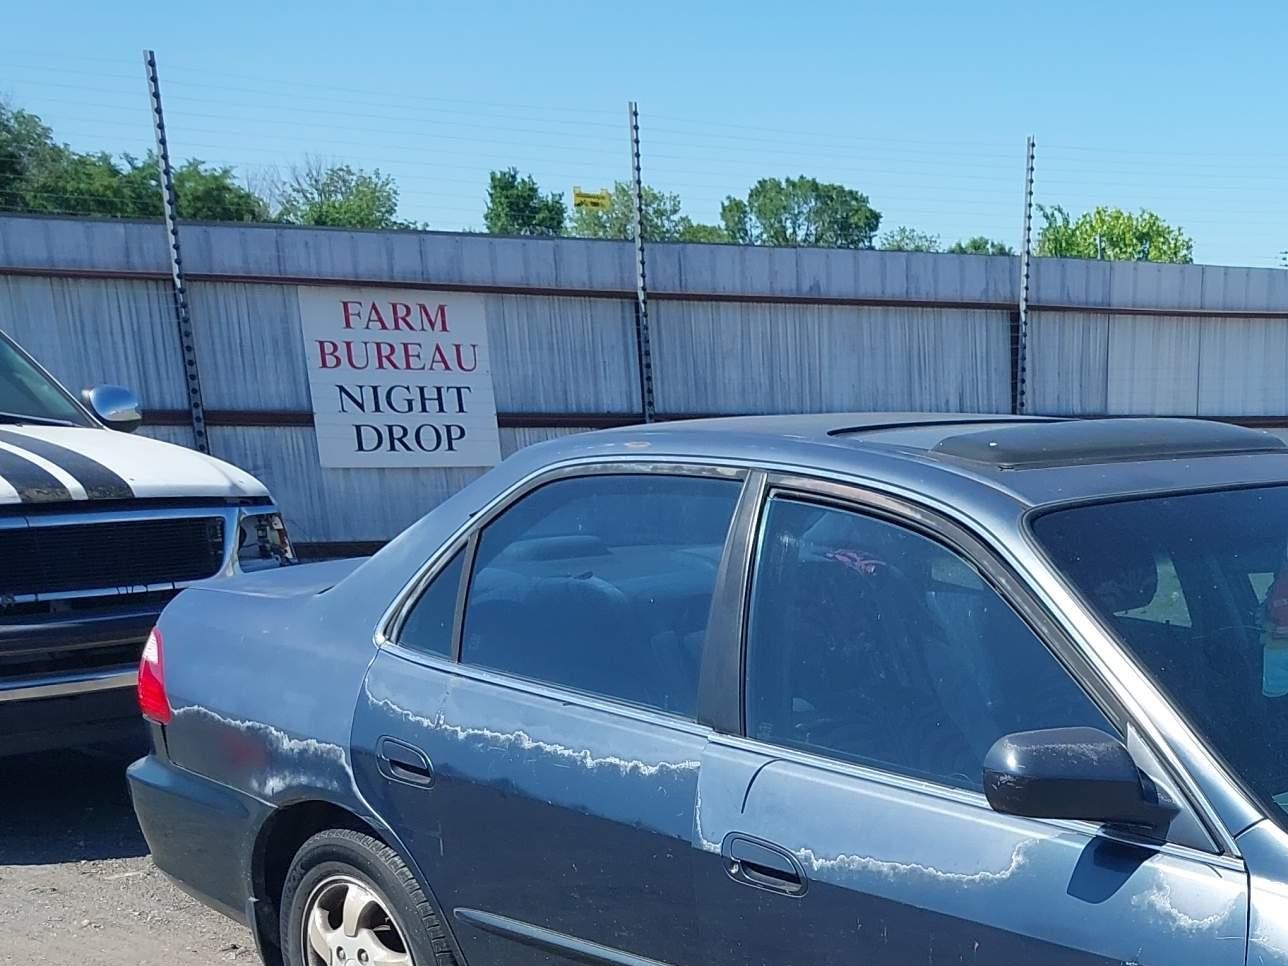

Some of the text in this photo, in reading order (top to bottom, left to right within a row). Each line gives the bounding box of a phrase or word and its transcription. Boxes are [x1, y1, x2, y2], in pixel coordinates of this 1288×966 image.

[340, 300, 451, 332] FARM
[315, 340, 479, 372] BUREAU
[336, 384, 472, 414] NIGHT
[352, 423, 466, 452] DROP
